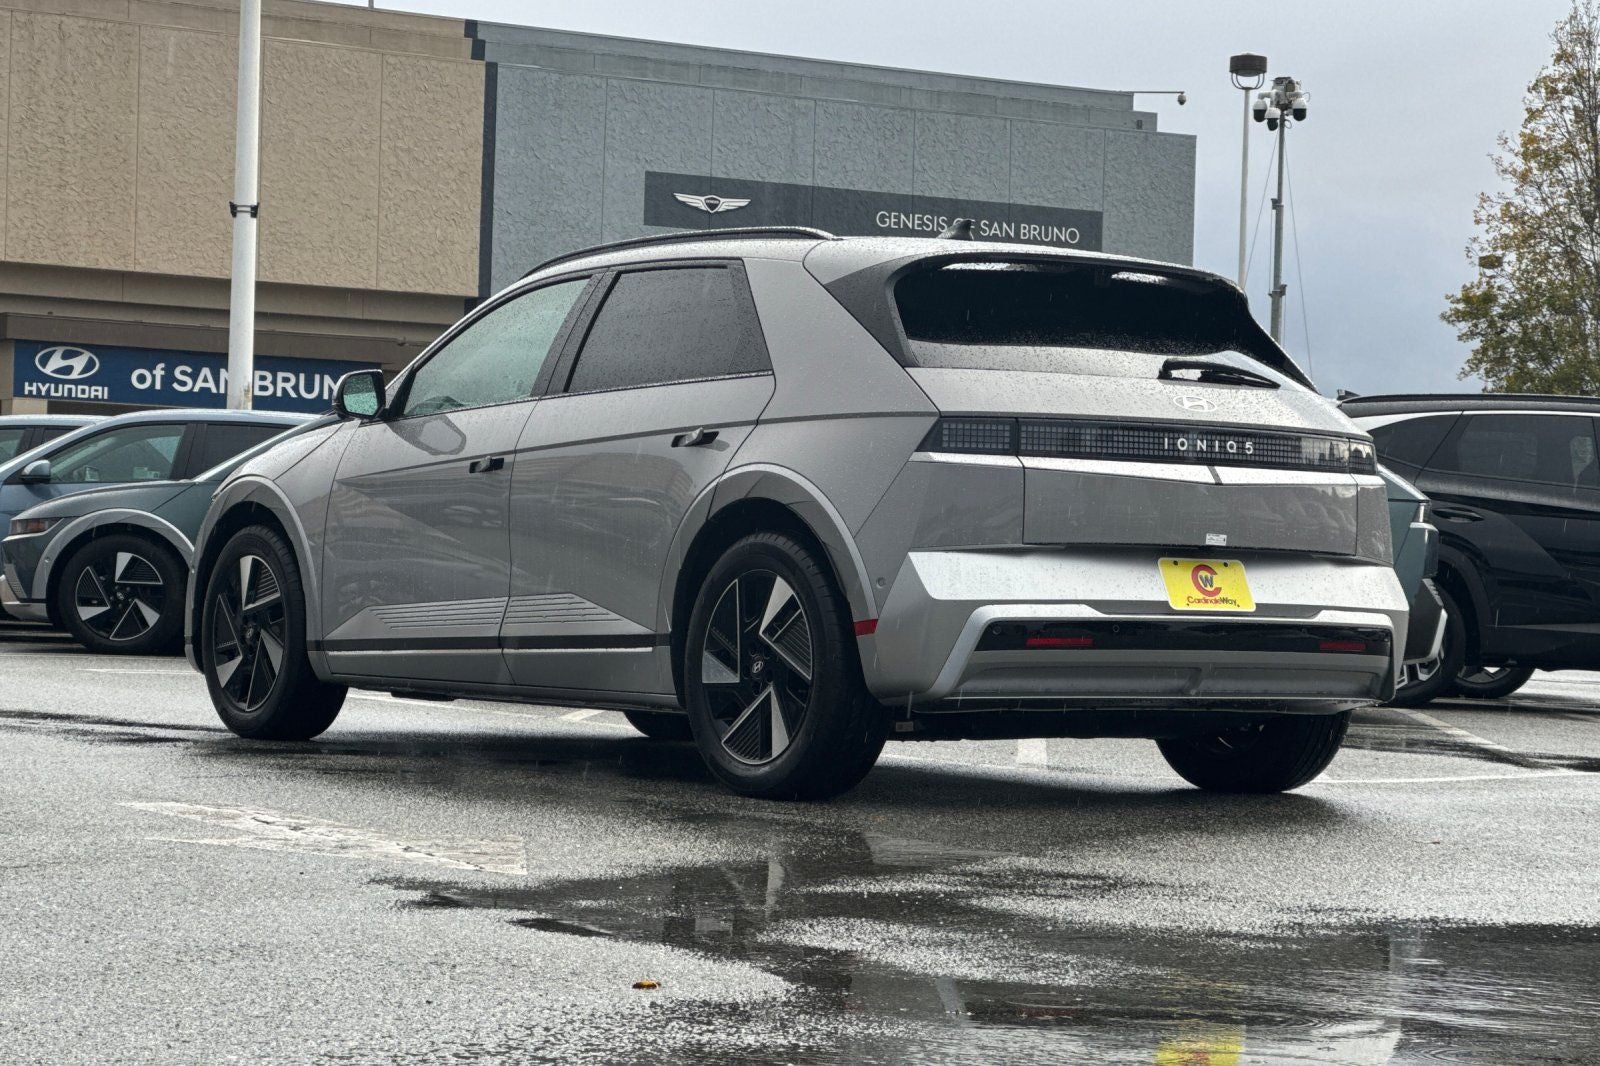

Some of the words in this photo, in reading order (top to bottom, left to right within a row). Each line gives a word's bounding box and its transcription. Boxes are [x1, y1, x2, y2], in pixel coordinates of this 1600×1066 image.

[876, 211, 948, 233] GENESIS
[980, 220, 1016, 239] SAN
[1020, 223, 1081, 244] BRUNO
[24, 381, 109, 400] HYUNDAI
[130, 362, 165, 390] of
[253, 370, 341, 401] BRUN
